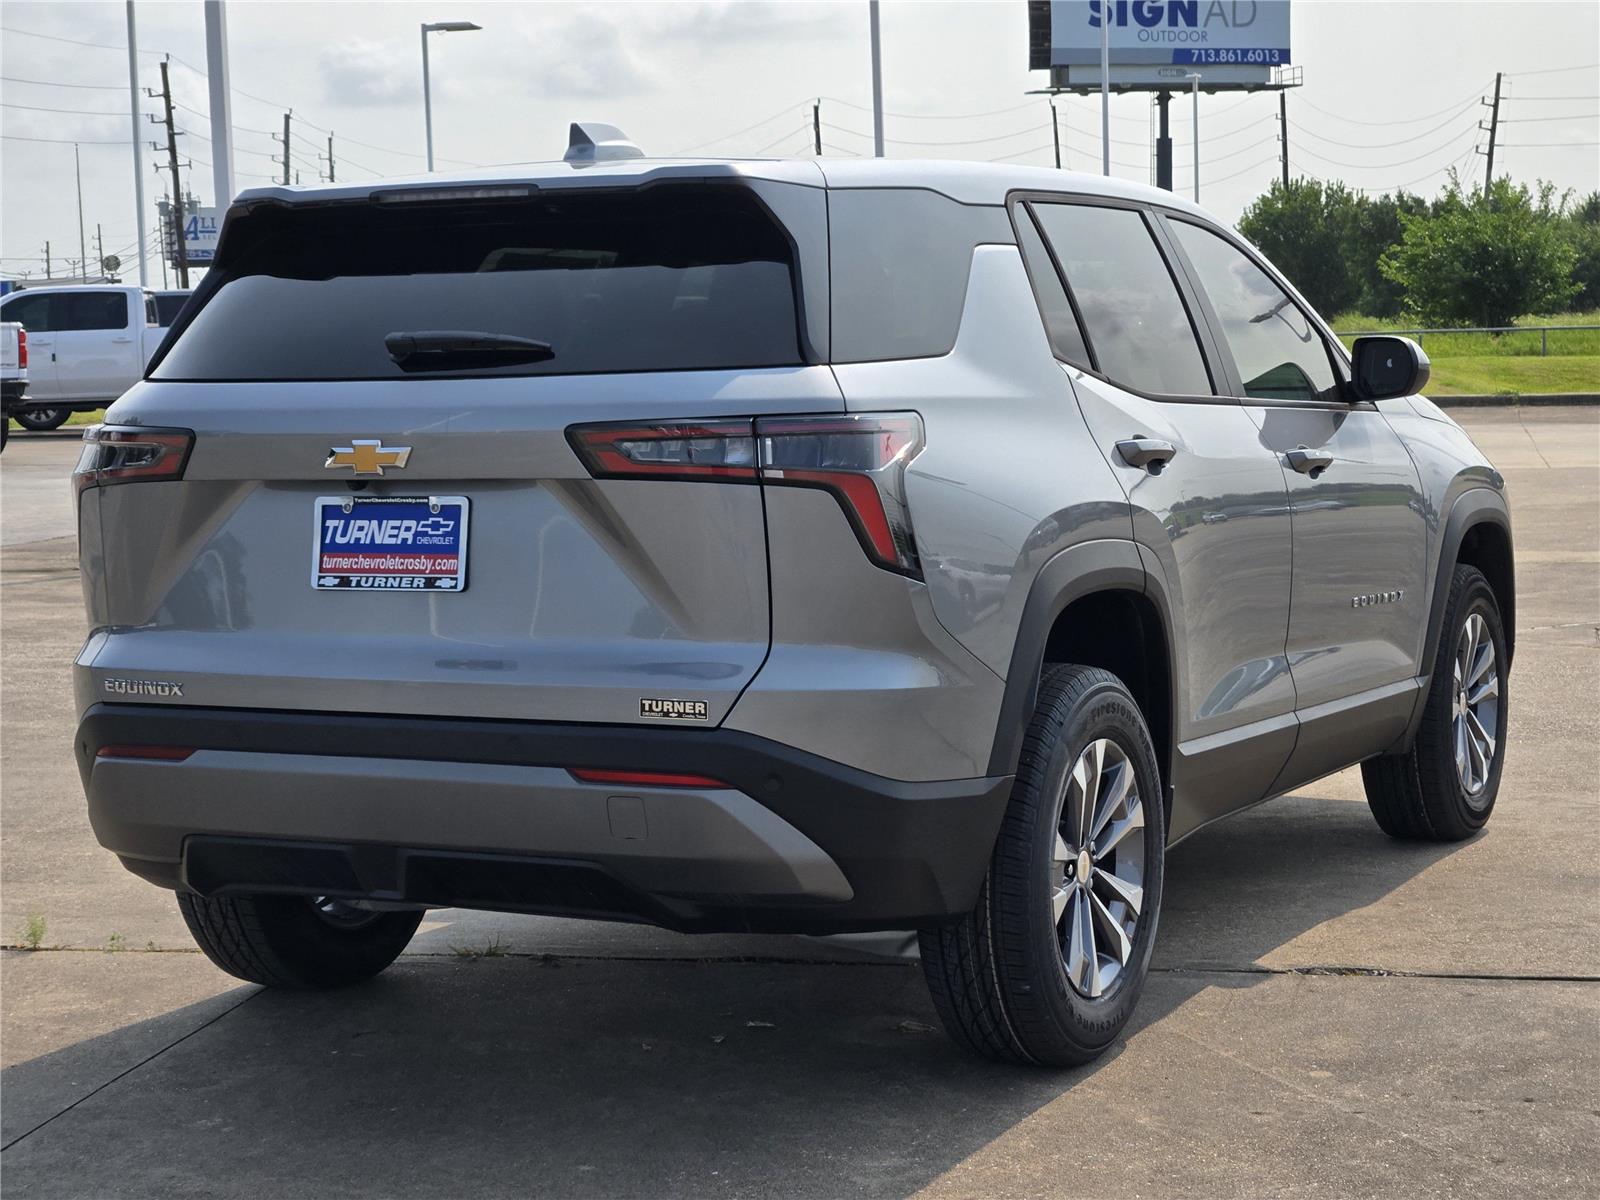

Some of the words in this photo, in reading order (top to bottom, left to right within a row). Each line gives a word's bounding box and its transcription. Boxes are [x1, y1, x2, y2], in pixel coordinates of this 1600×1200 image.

[1088, 0, 1198, 28] SIGN
[1203, 0, 1257, 28] AD
[1138, 29, 1208, 42] OUTDOOR
[1191, 50, 1279, 62] 713.861.6013
[324, 519, 417, 545] TURNER
[416, 536, 454, 545] CHEVROLET
[322, 554, 458, 574] turnerchevroletcrosby.com
[350, 576, 426, 588] TURNER
[104, 678, 184, 696] EQUINOX
[642, 700, 706, 714] TURNER
